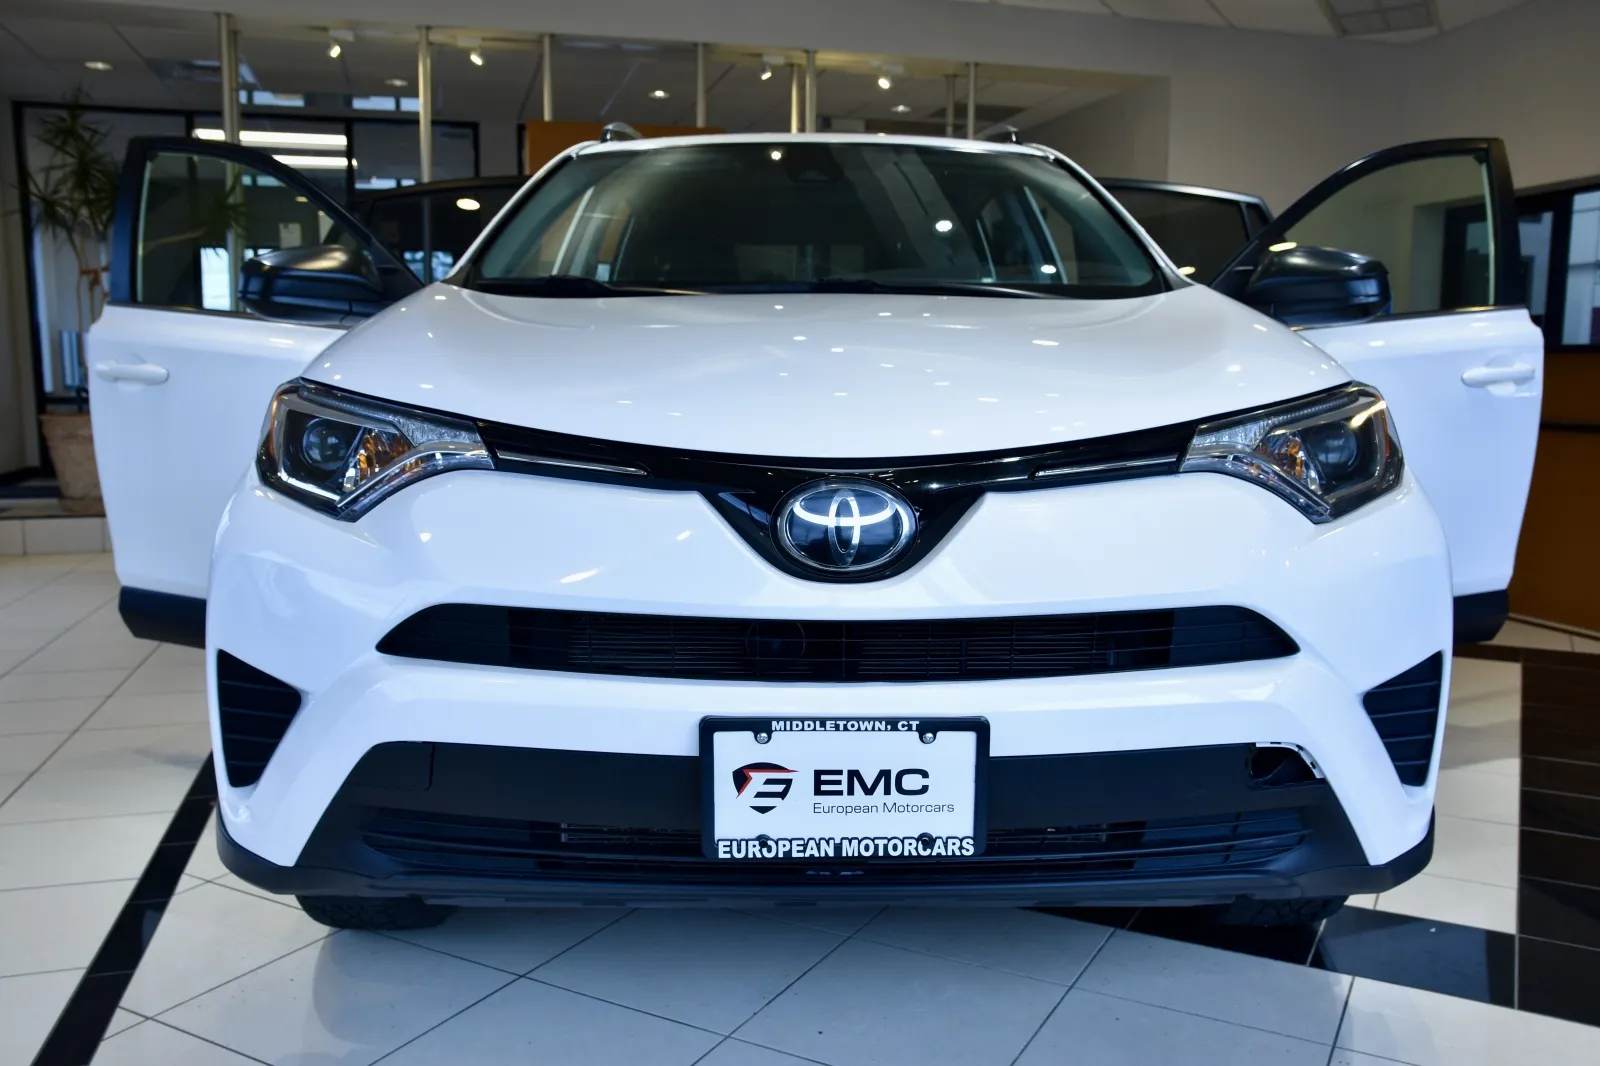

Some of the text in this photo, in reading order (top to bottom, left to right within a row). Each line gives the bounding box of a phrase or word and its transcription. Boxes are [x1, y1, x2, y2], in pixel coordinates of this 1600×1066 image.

[771, 720, 919, 732] MIDDLETOWN, CT
[813, 768, 930, 796] EMC
[813, 802, 955, 815] European Motorcars
[718, 838, 834, 859] EUROPEAN
